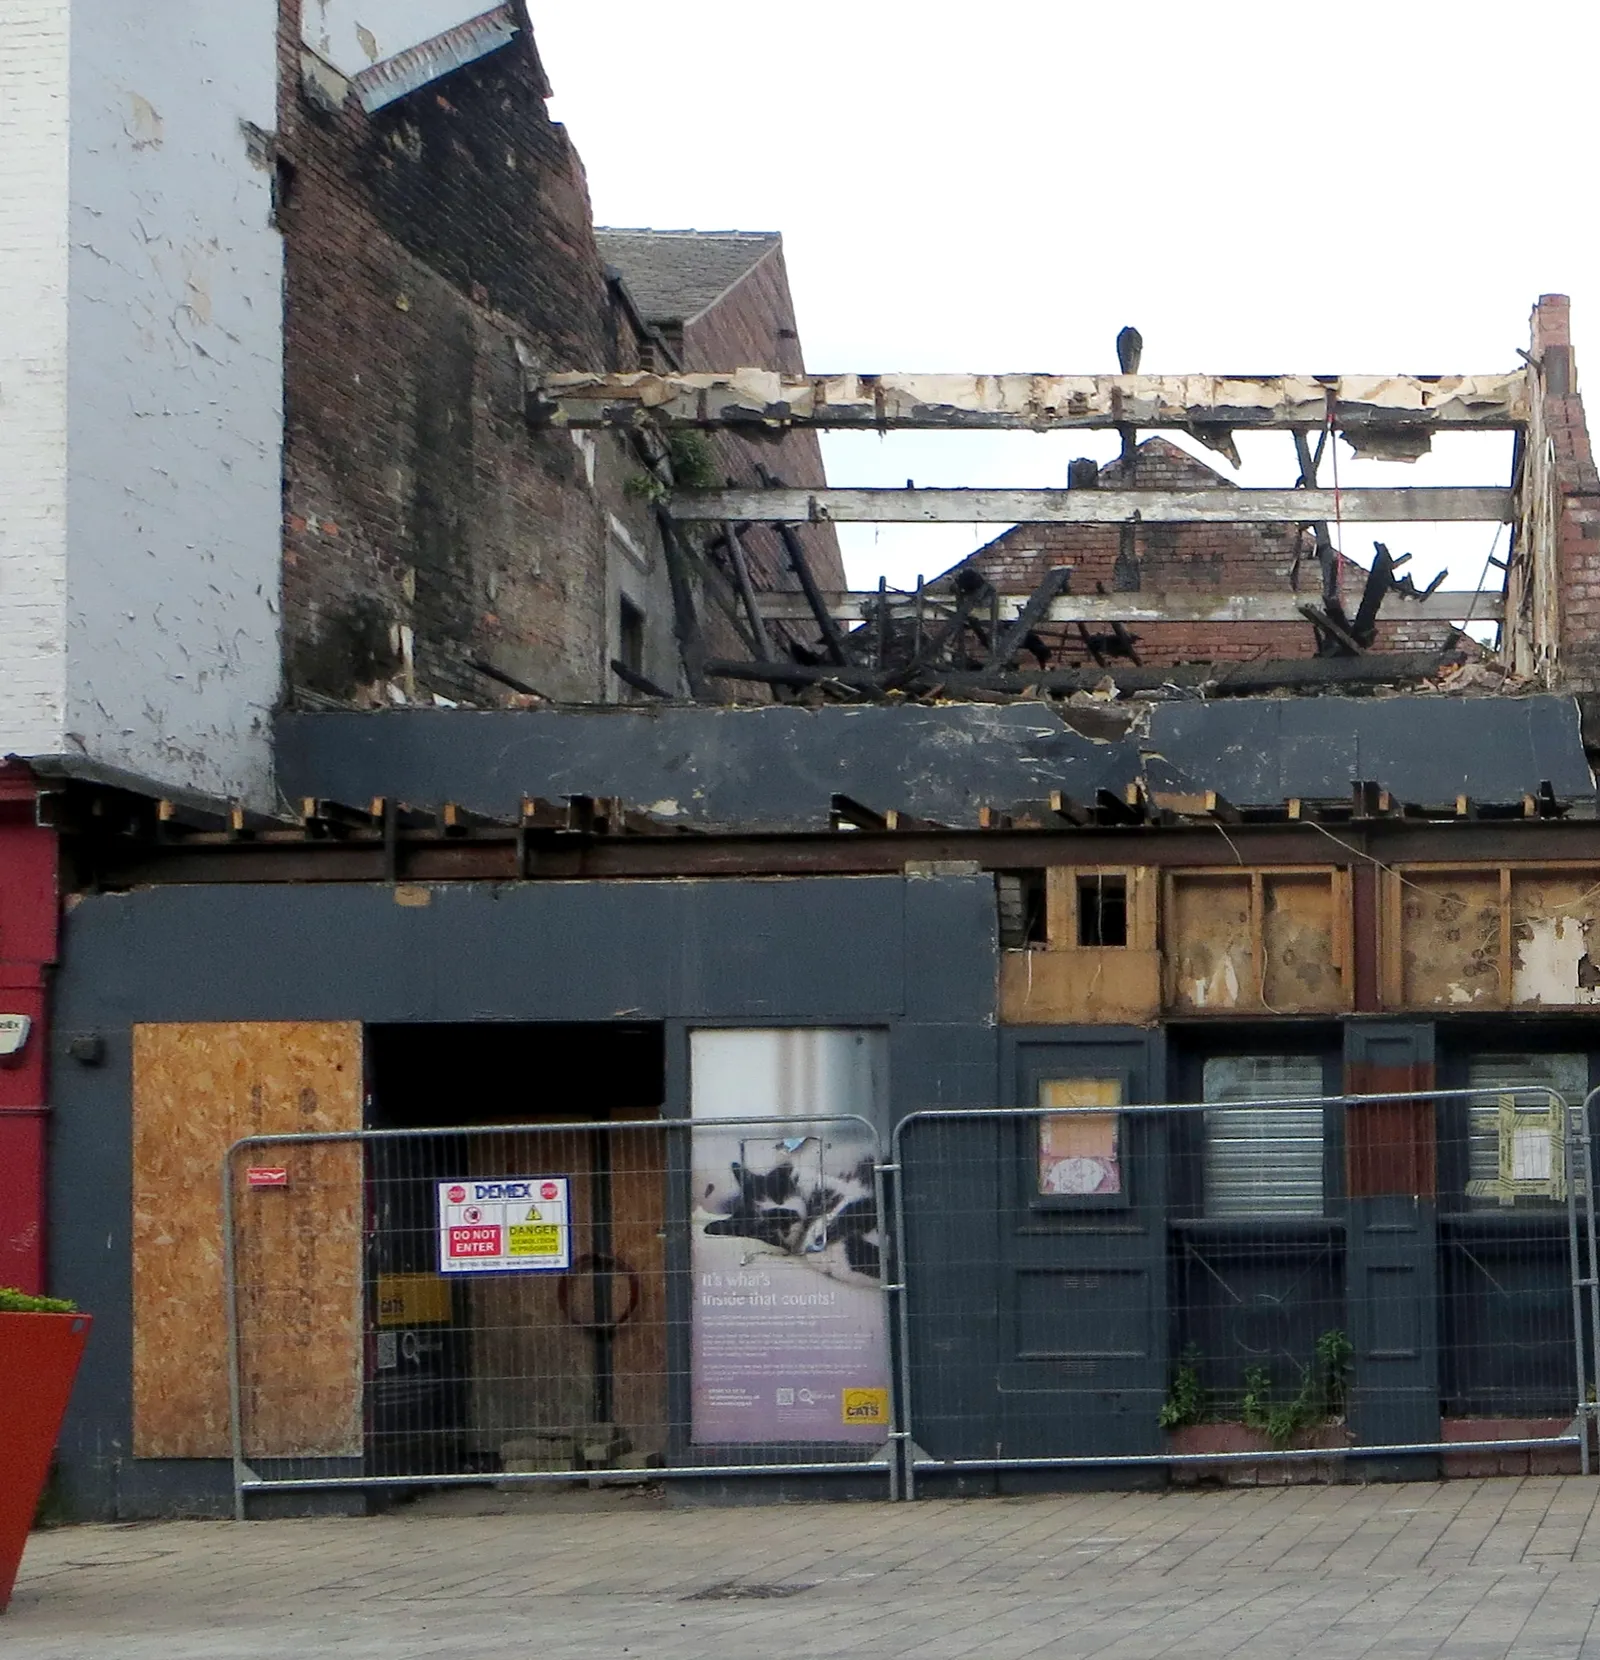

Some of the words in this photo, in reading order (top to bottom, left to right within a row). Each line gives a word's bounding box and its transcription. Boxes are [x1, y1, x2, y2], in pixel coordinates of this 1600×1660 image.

[475, 1184, 532, 1200] DEMEX
[453, 1231, 470, 1240] DO
[473, 1229, 496, 1240] NOT
[509, 1225, 558, 1236] DANGER
[456, 1242, 494, 1253] ENTER
[702, 1273, 722, 1287] It's
[728, 1273, 771, 1287] what's
[702, 1291, 745, 1306] inside
[750, 1291, 776, 1306] that
[783, 1291, 835, 1306] counts!
[846, 1406, 879, 1417] CATS
